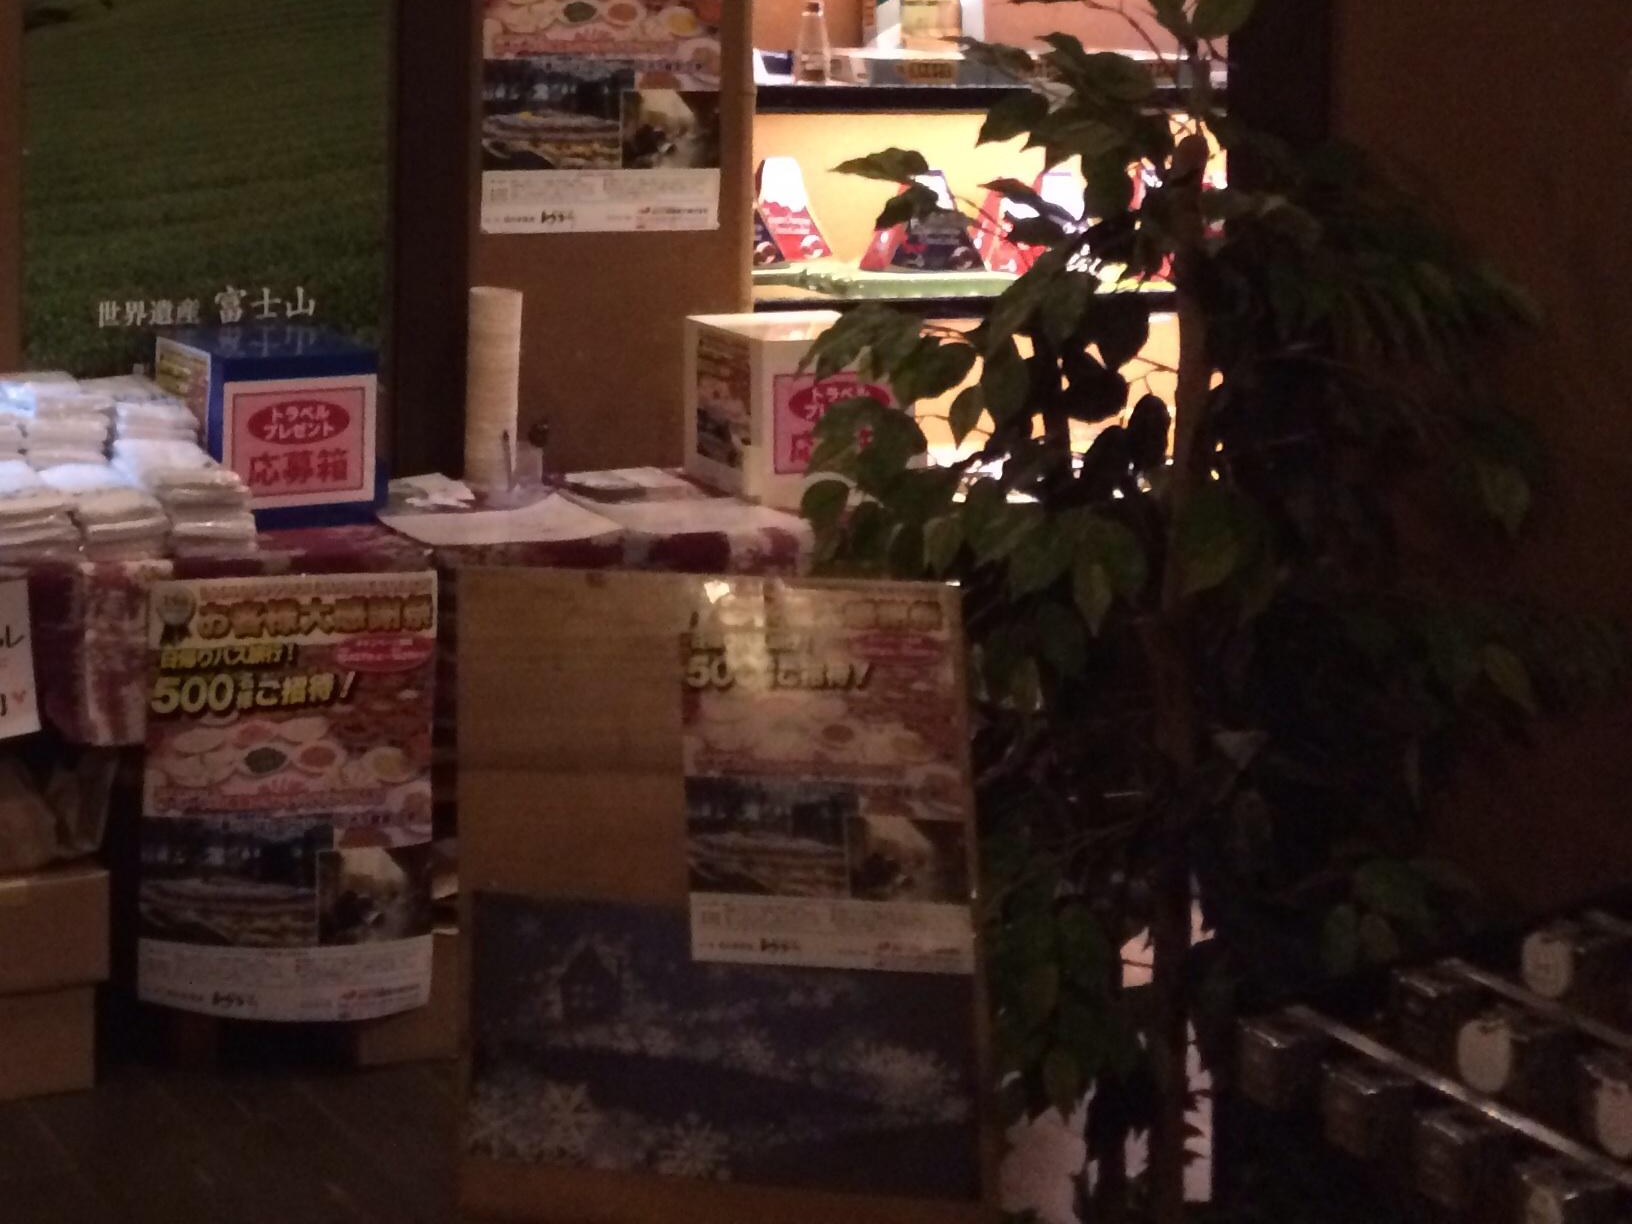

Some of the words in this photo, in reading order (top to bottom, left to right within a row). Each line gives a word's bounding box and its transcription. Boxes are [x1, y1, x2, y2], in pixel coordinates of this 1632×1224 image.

[98, 298, 200, 328] 世界遺産
[214, 284, 316, 325] 富士山
[271, 403, 330, 423] トラベル
[263, 421, 336, 441] プレゼント
[249, 448, 348, 486] 応募箱
